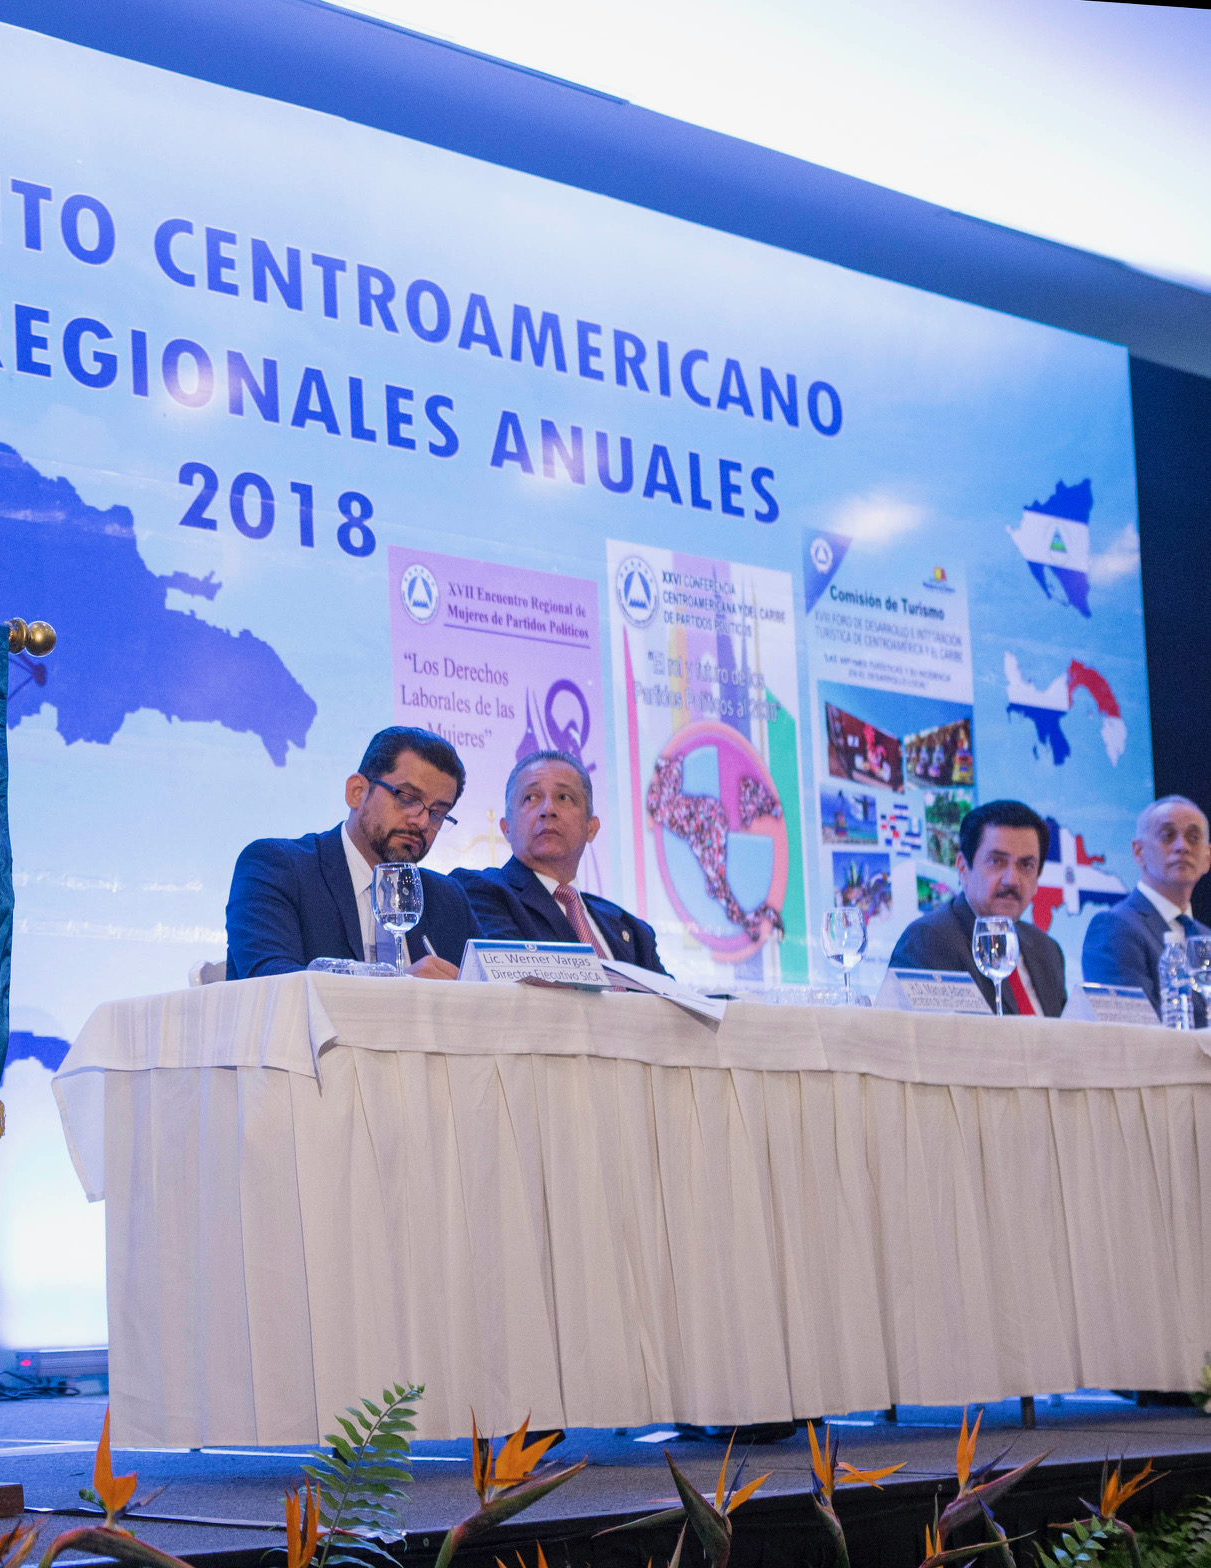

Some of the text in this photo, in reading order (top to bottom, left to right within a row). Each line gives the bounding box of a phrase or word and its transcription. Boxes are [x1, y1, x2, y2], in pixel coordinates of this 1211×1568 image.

[153, 217, 844, 437] CENTROAMERICANO
[489, 410, 781, 525] ANUALES
[178, 461, 377, 558] 2018
[448, 582, 587, 618] XVII Encuentro Regional de
[662, 571, 735, 595] XXVI CONFERENCIA
[663, 591, 736, 615] CENTROAMERICANA
[759, 607, 786, 624] CARIBE
[830, 585, 945, 621] Comisión de Turismo
[447, 603, 489, 624] Mujeres
[491, 611, 504, 626] de
[506, 613, 547, 633] Partidos
[549, 621, 589, 639] Políticos
[664, 611, 674, 625] DE
[676, 612, 713, 631] PARTIDOS
[443, 657, 509, 686] Derechos
[400, 684, 515, 720] Laborales de las
[634, 680, 683, 711] Partidos
[482, 953, 591, 968] Lic. Werner Vargas
[580, 972, 603, 982] SICA
